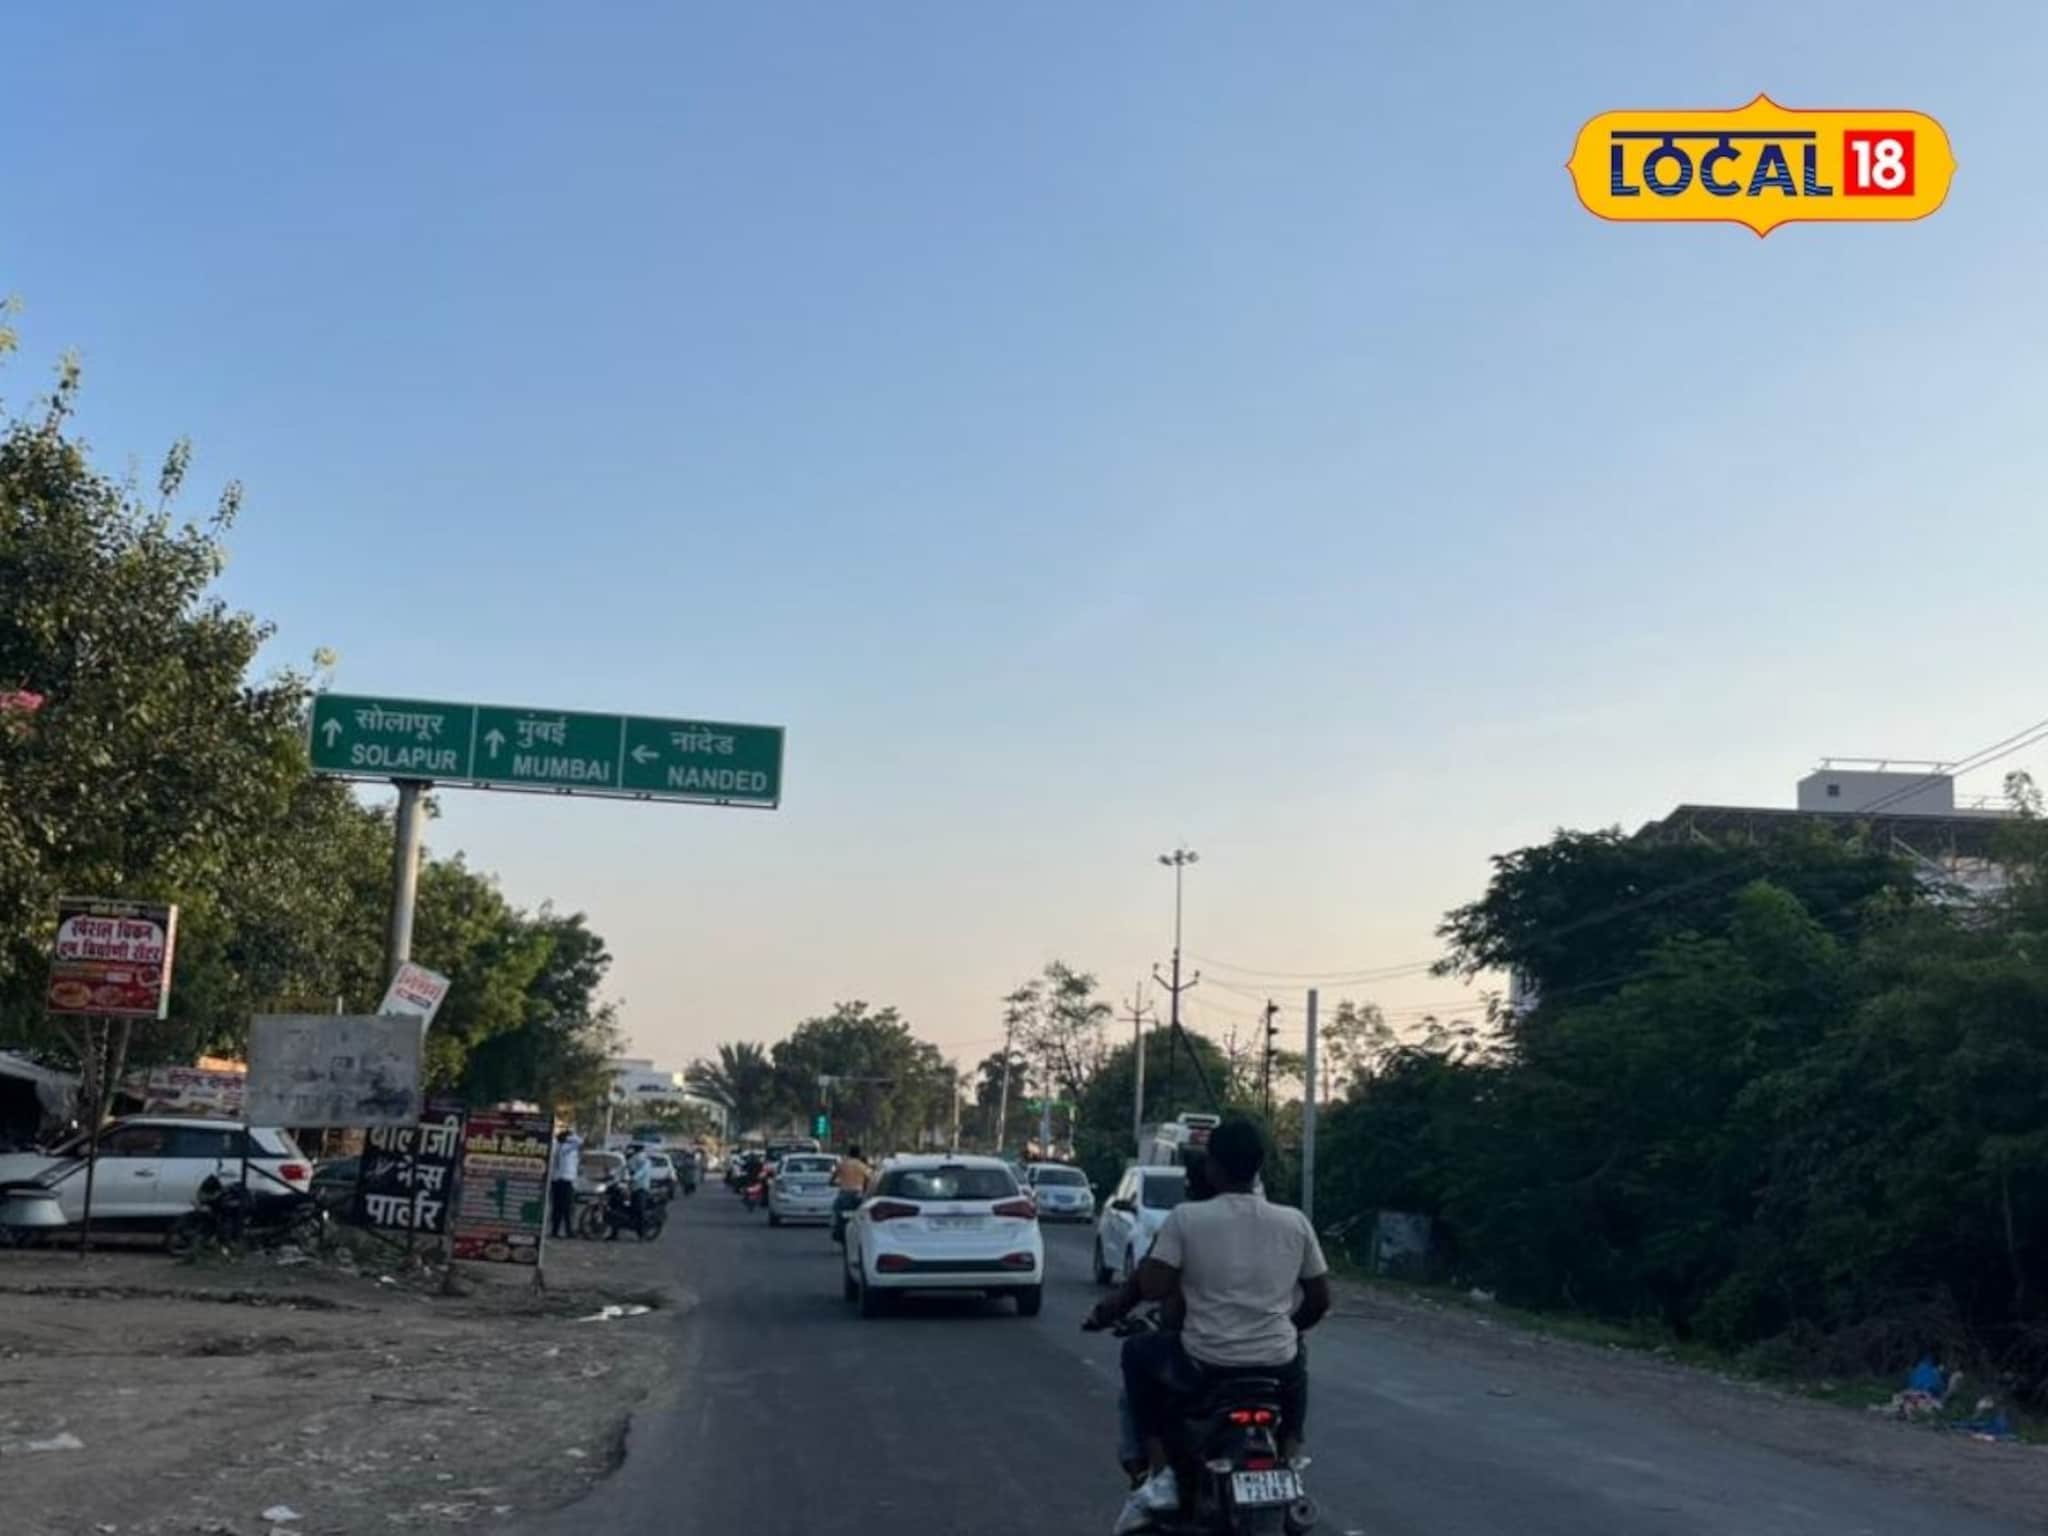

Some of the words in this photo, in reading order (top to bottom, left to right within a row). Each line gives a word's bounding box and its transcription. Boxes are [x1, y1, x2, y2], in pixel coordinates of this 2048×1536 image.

[354, 704, 445, 741] सोलापूर
[516, 713, 567, 749] मुंबई
[670, 725, 736, 755] नांदेड
[351, 743, 457, 770] SOLAPUR
[512, 754, 610, 781] MUMBAI
[667, 765, 768, 792] NANDED
